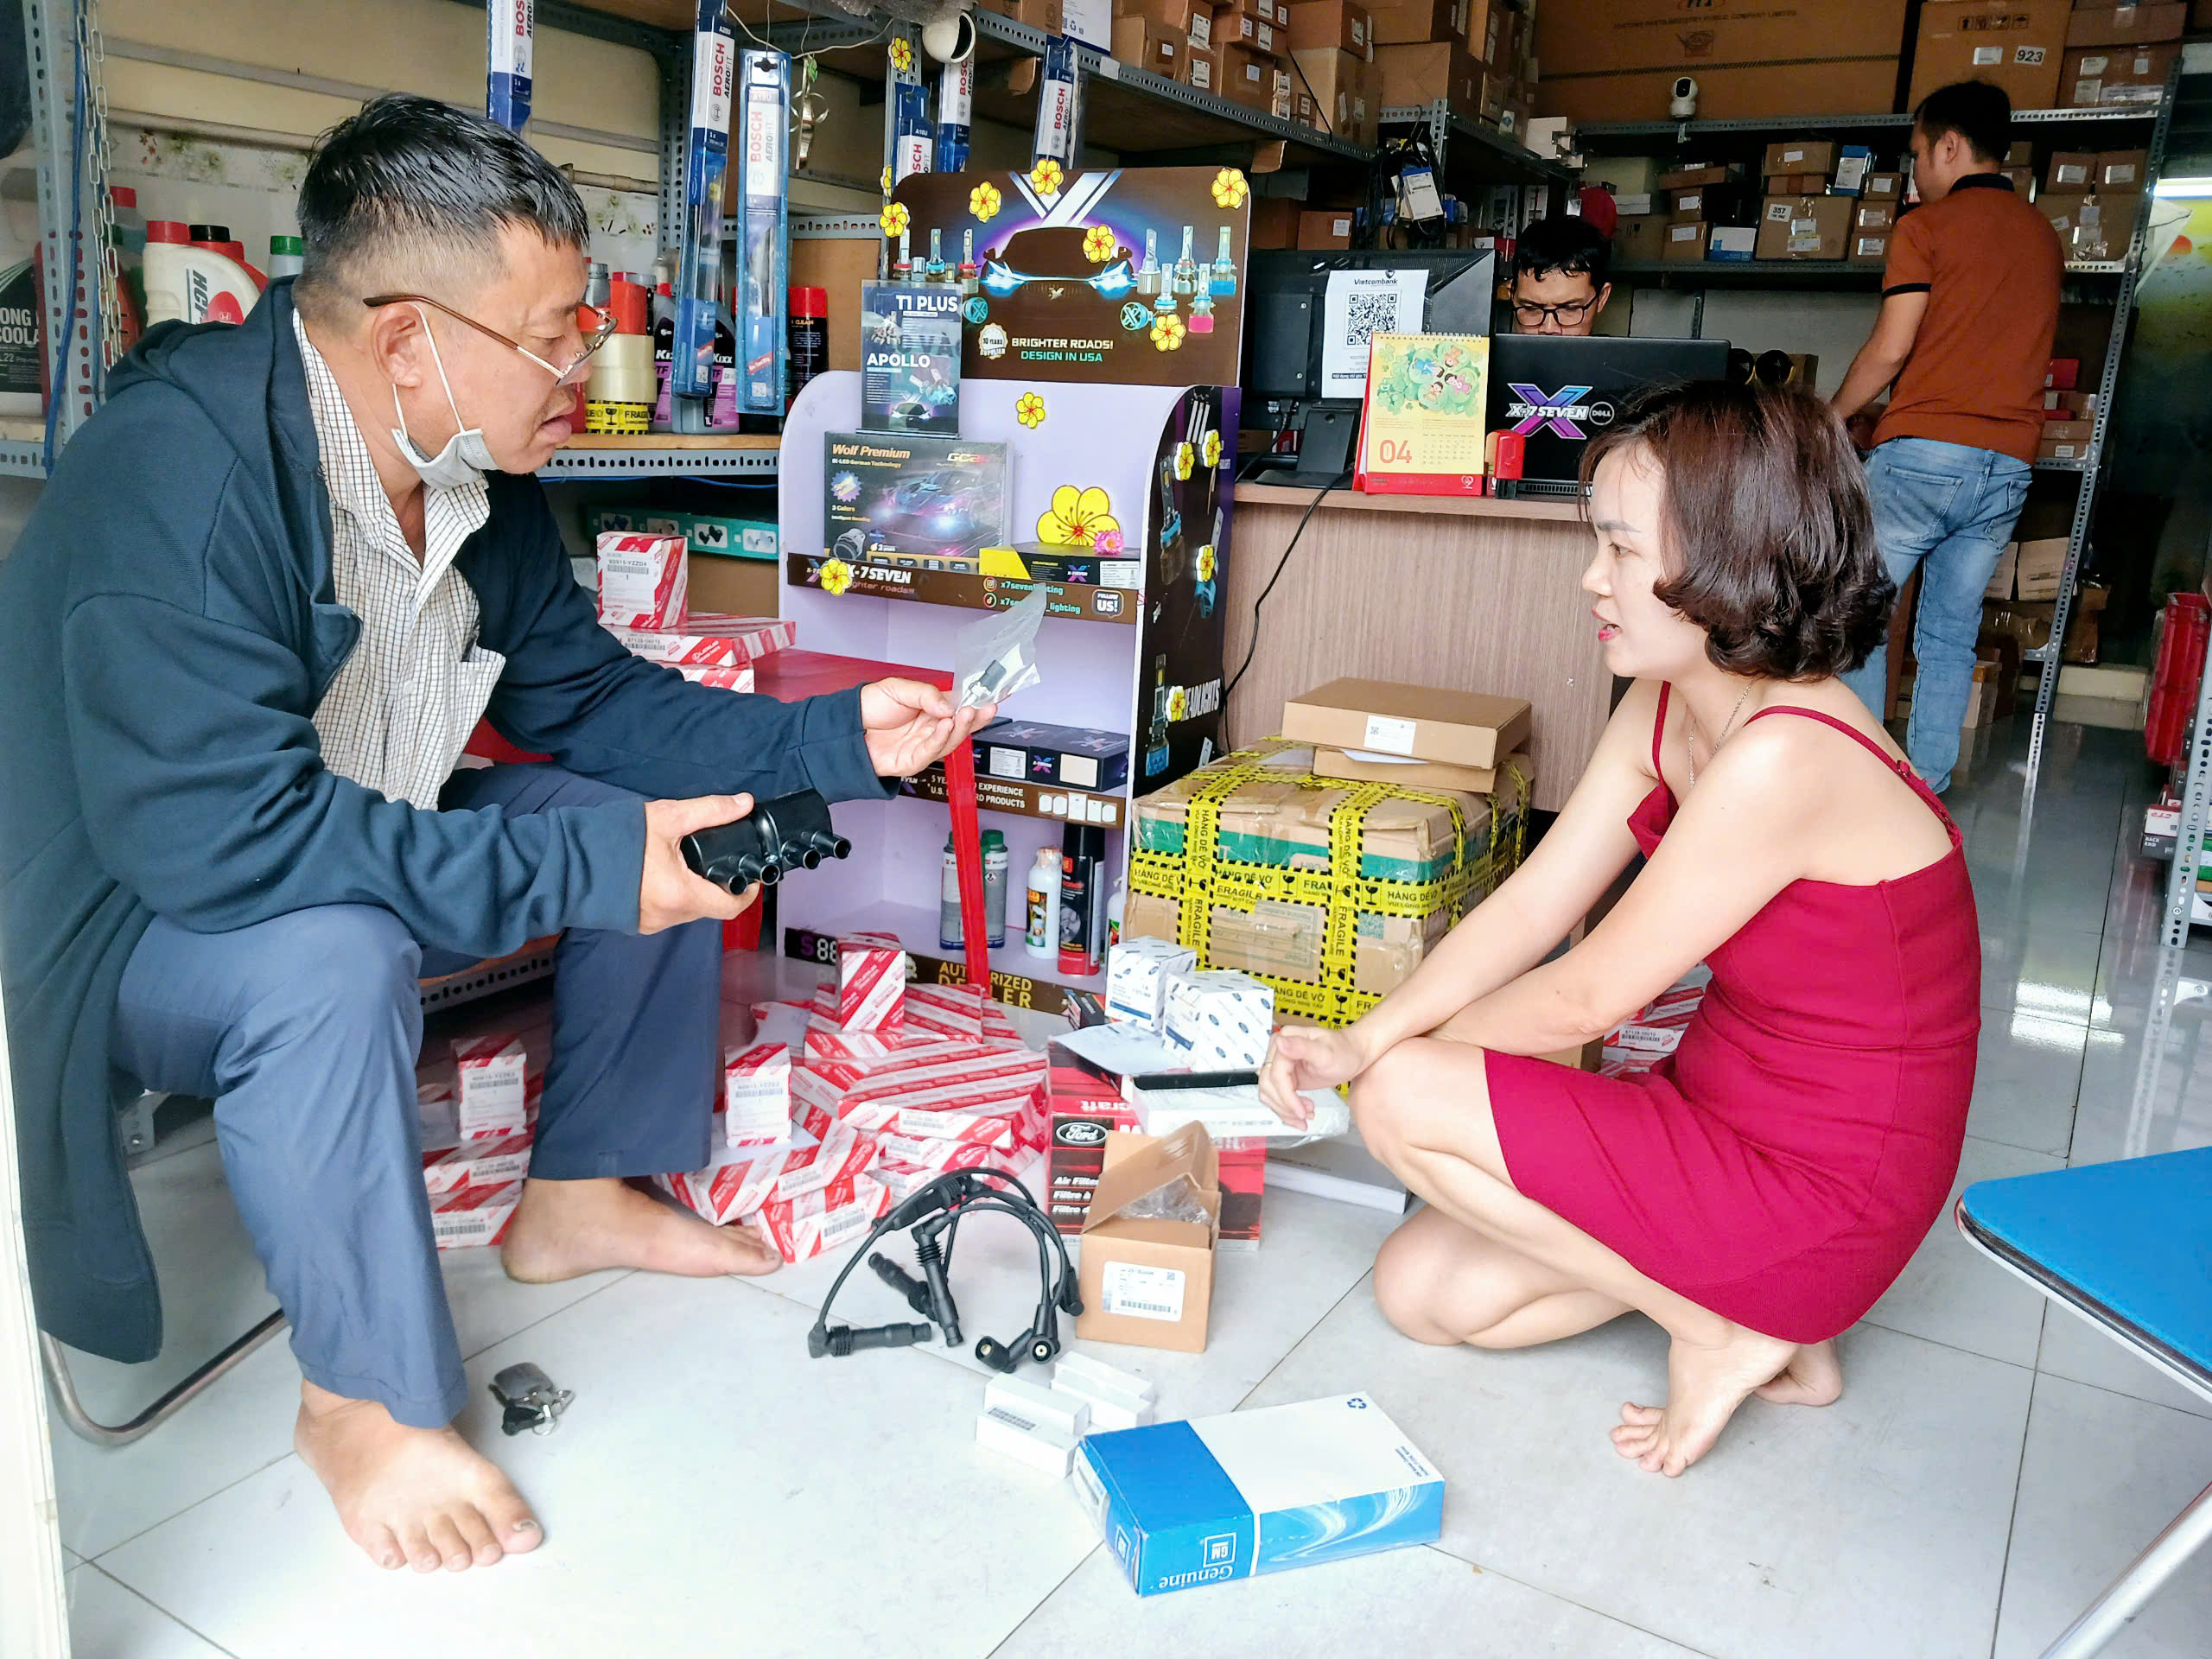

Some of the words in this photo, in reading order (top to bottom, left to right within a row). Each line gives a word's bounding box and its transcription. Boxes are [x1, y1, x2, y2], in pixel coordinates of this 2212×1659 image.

[516, 0, 525, 36] BOS
[2016, 49, 2044, 63] 923
[713, 42, 726, 97] BOSCH
[724, 57, 734, 99] AEROFIT
[959, 60, 968, 96] BOSC
[1054, 88, 1065, 130] BOSCH
[750, 111, 763, 163] BOSCH
[912, 143, 923, 173] SCH
[895, 295, 912, 310] T1
[917, 296, 958, 312] PLUS
[0, 307, 31, 327] ONG
[1011, 337, 1068, 348] BRIGHTER
[1073, 340, 1114, 350] ROADS!
[867, 353, 931, 368] APOLLO
[1020, 350, 1063, 361] DESIGN
[1065, 352, 1077, 361] IN
[1079, 353, 1103, 362] USA
[832, 443, 859, 456] Wolf
[860, 445, 911, 459] Premium
[1379, 439, 1413, 464] 04
[847, 563, 912, 584] X-7SEVEN
[850, 582, 878, 590] ghter
[1096, 600, 1118, 612] US!
[978, 783, 1024, 797] EXPERIENCE
[985, 795, 1026, 809] PRODUCTS
[1335, 906, 1347, 957] FRAGILE
[939, 961, 1033, 991] AUTRIZED
[1065, 1124, 1098, 1141] Ford
[1053, 1176, 1071, 1186] Air
[1052, 1191, 1082, 1200] Filtre
[1211, 1546, 1229, 1560] GM
[1159, 1565, 1234, 1589] Genuine
